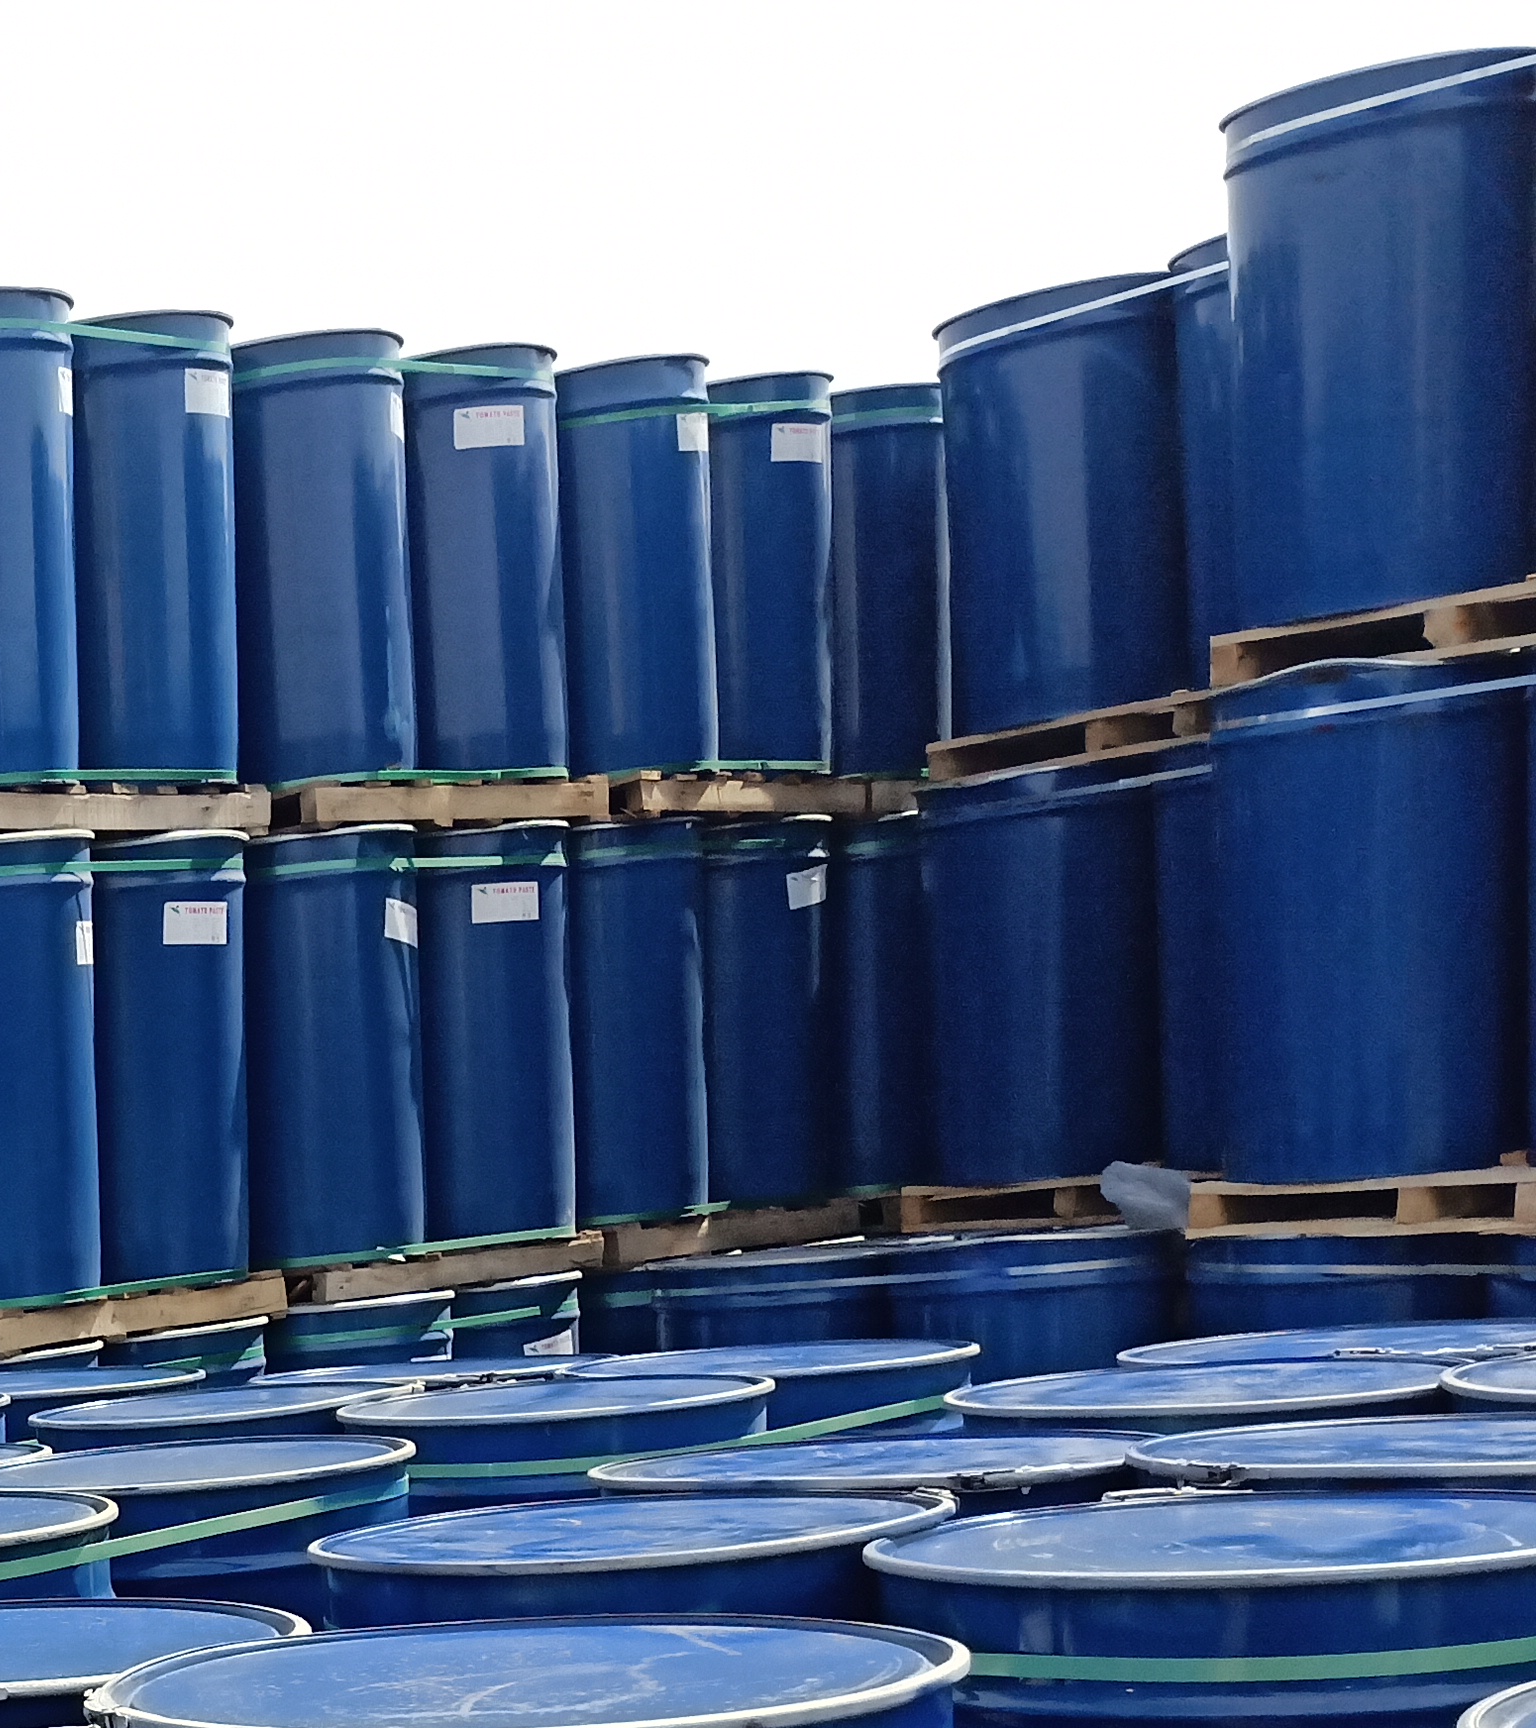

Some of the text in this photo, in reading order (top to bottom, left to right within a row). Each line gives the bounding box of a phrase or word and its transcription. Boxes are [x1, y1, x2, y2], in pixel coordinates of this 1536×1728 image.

[492, 886, 535, 895] TOMATO PASTE
[185, 906, 225, 914] TOMATO PASTE
